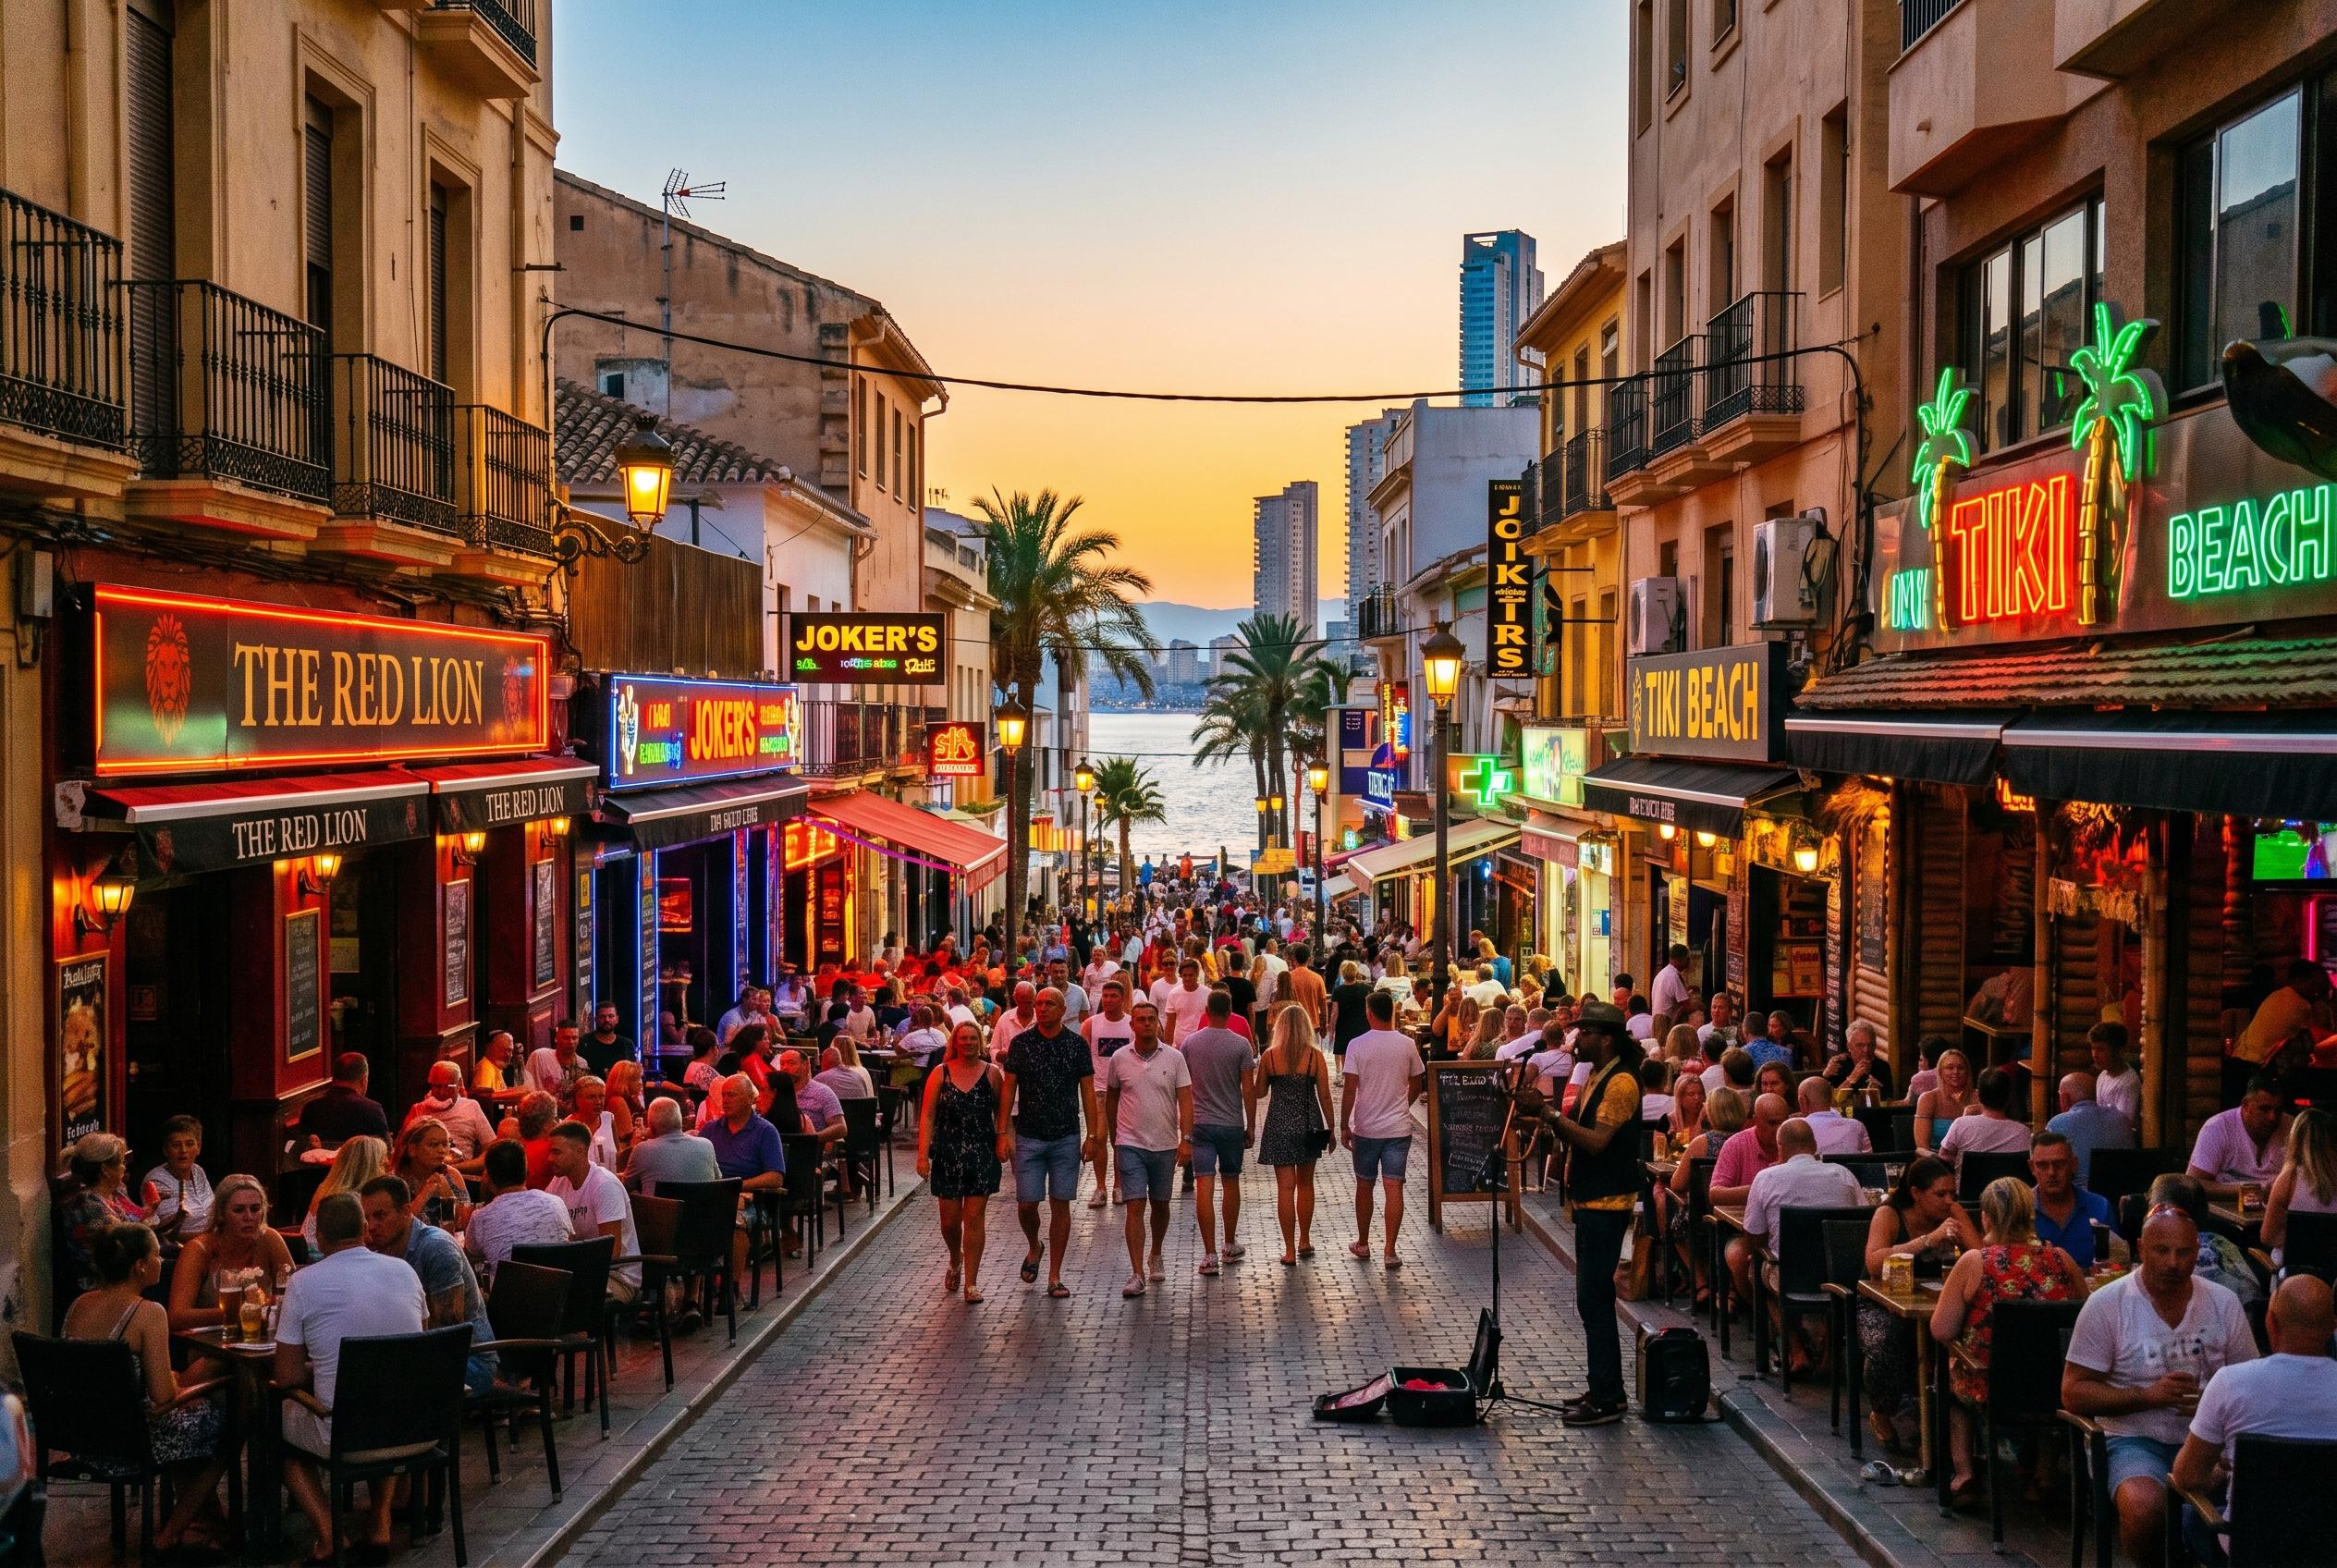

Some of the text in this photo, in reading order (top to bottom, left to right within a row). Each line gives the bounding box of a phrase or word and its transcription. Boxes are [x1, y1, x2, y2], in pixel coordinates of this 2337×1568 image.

[1952, 474, 2068, 621] TIKI
[2168, 485, 2330, 599] BEACH
[796, 625, 937, 653] JOKER'S
[234, 641, 483, 727] THE RED LION
[1646, 661, 1758, 741] TIKI BEACH
[691, 699, 756, 760] JOKER'S
[232, 808, 367, 860] THE RED LION
[485, 786, 565, 823] THE RED LION
